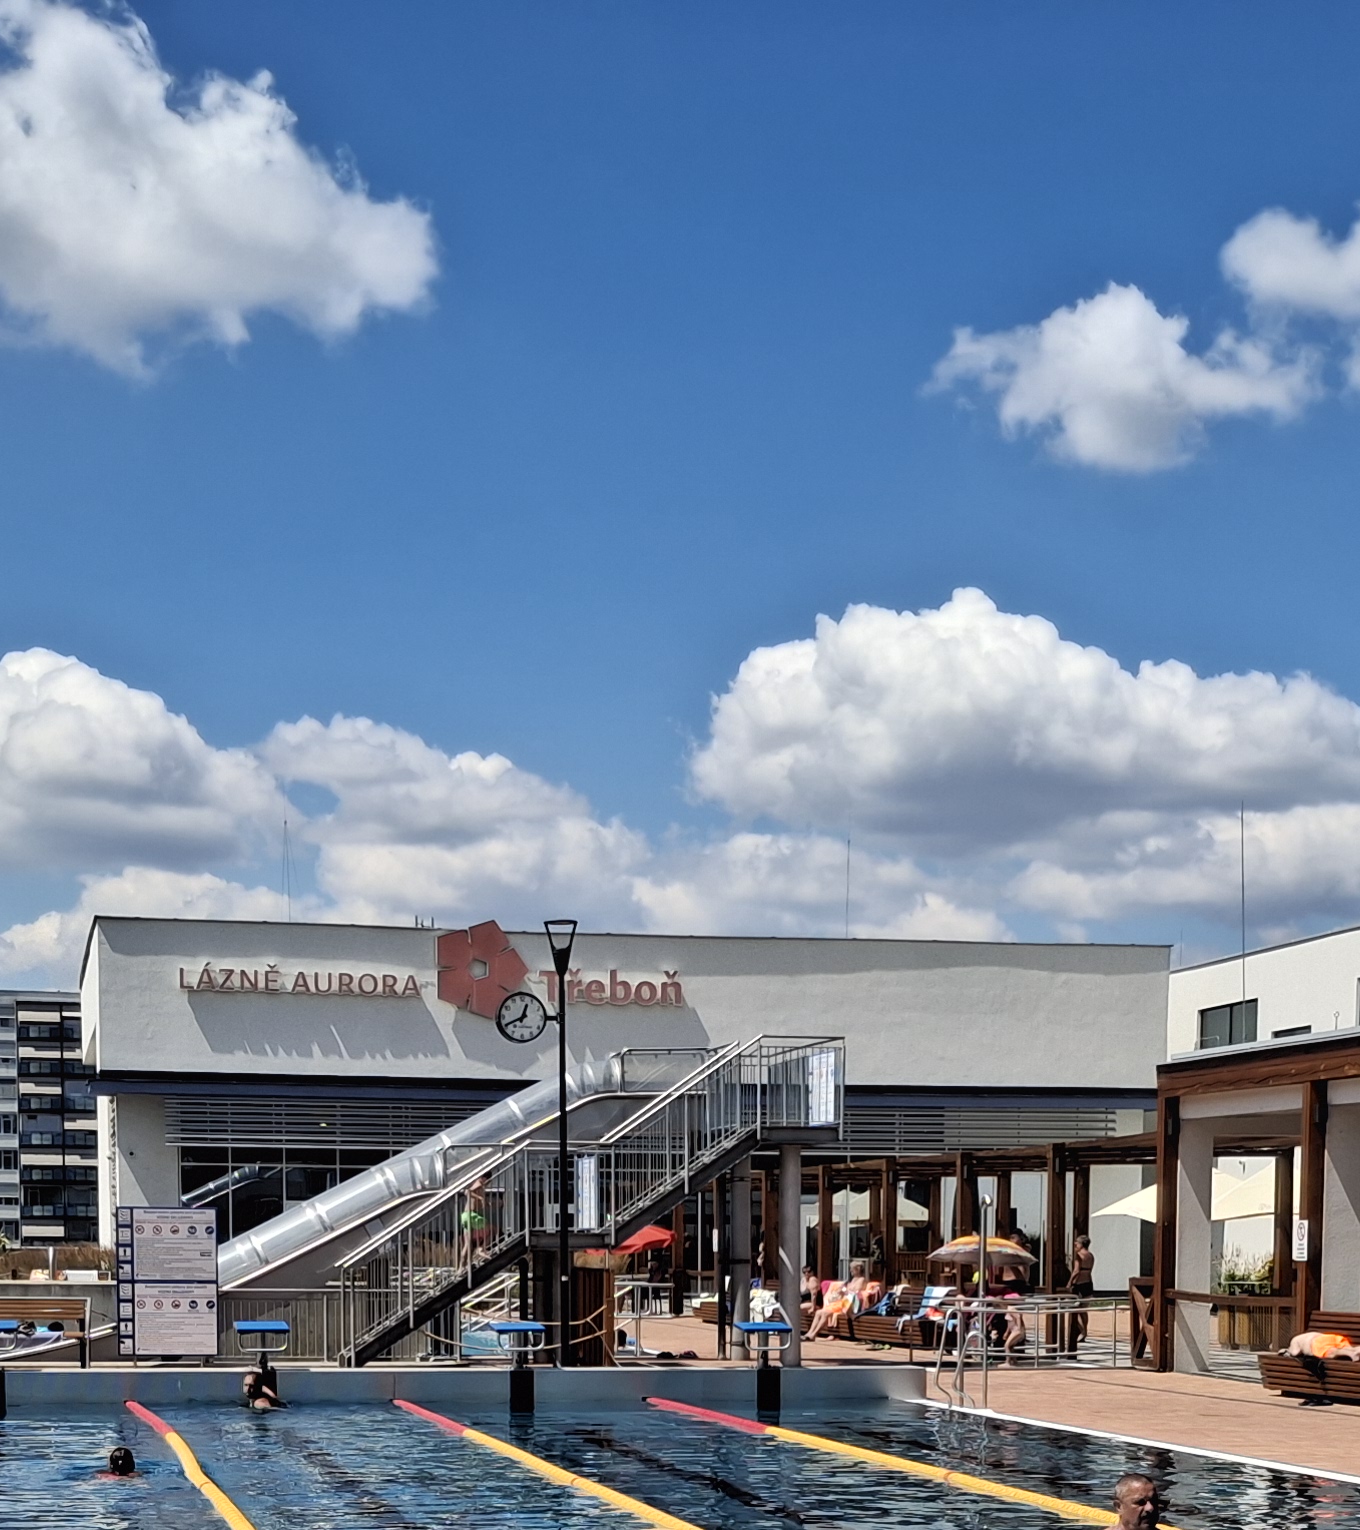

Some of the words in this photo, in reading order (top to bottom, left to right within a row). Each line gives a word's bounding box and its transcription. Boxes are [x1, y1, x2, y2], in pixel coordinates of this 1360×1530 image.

[178, 962, 281, 992] LÁZNĚ
[291, 971, 421, 996] AURORA
[539, 968, 682, 1005] Třeboň
